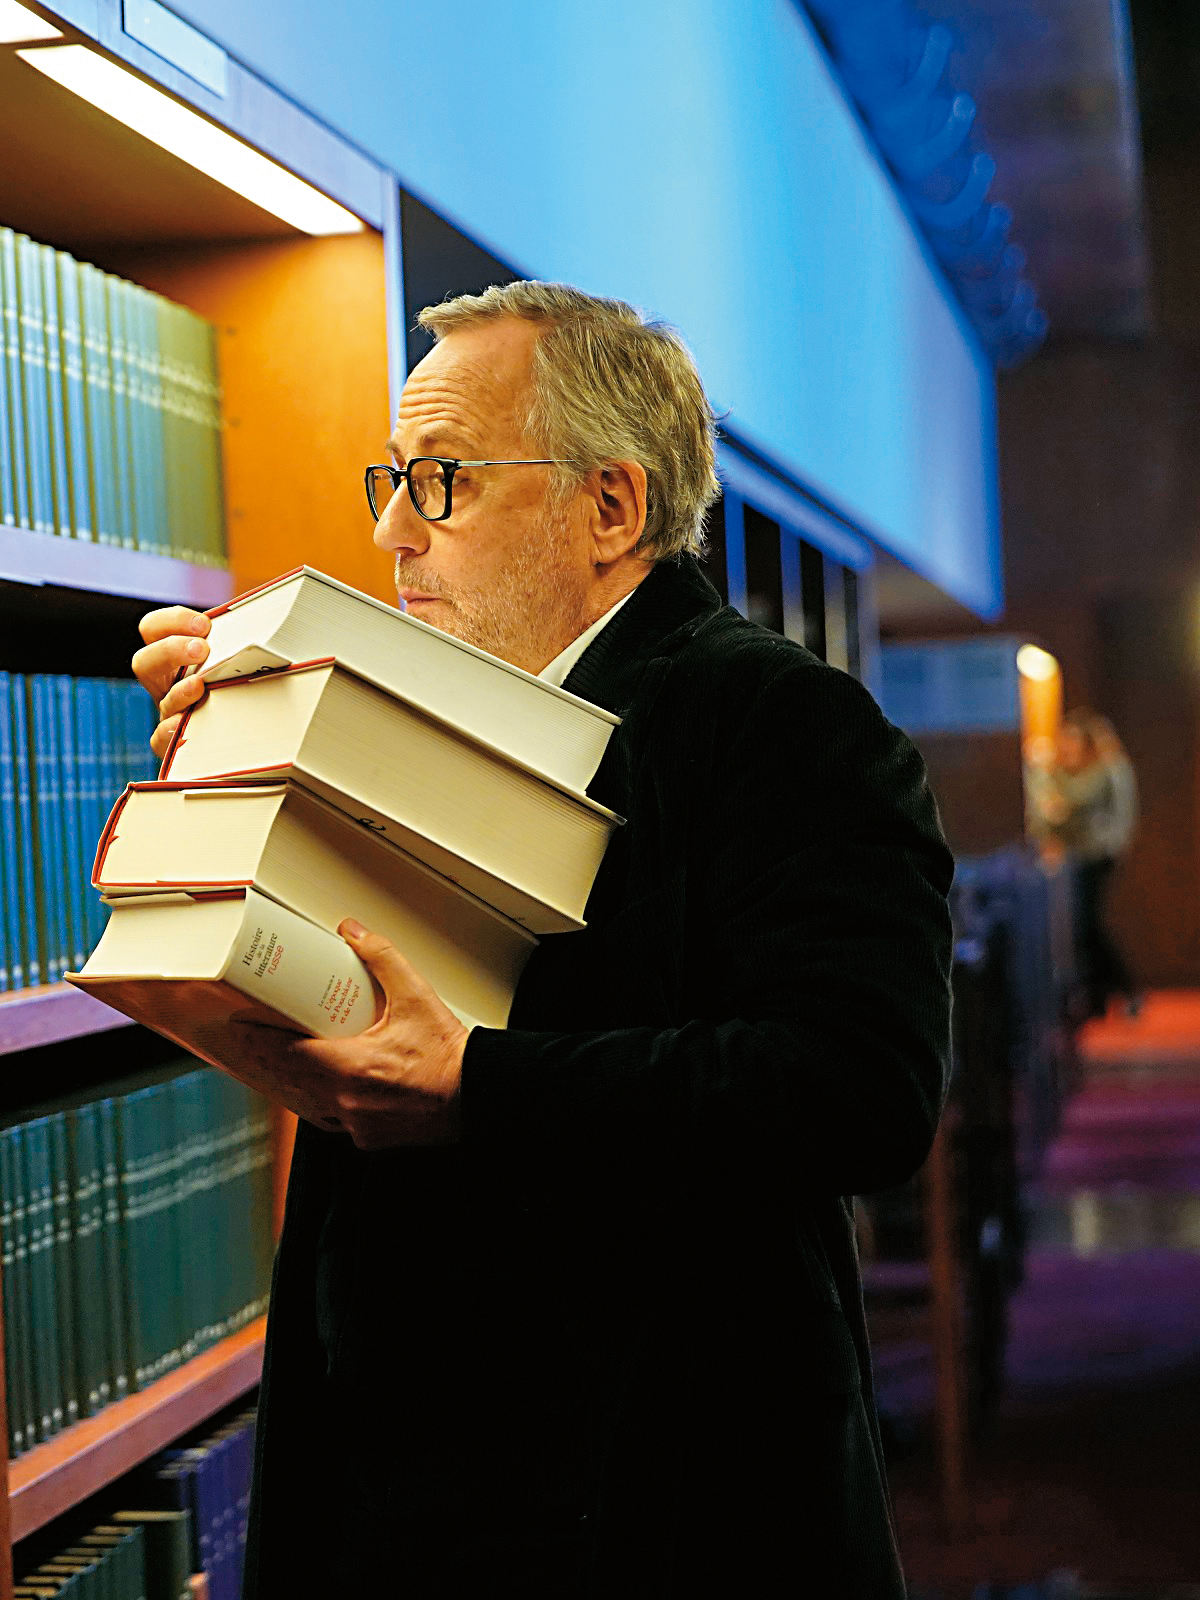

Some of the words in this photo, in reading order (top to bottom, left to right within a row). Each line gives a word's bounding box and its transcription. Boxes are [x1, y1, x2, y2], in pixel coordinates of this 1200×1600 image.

[242, 927, 263, 966] Histoire
[267, 944, 284, 975] russe
[333, 977, 353, 1014] Pouchkine
[347, 985, 360, 1008] Gogol
[329, 1012, 338, 1023] de
[344, 1006, 351, 1017] de
